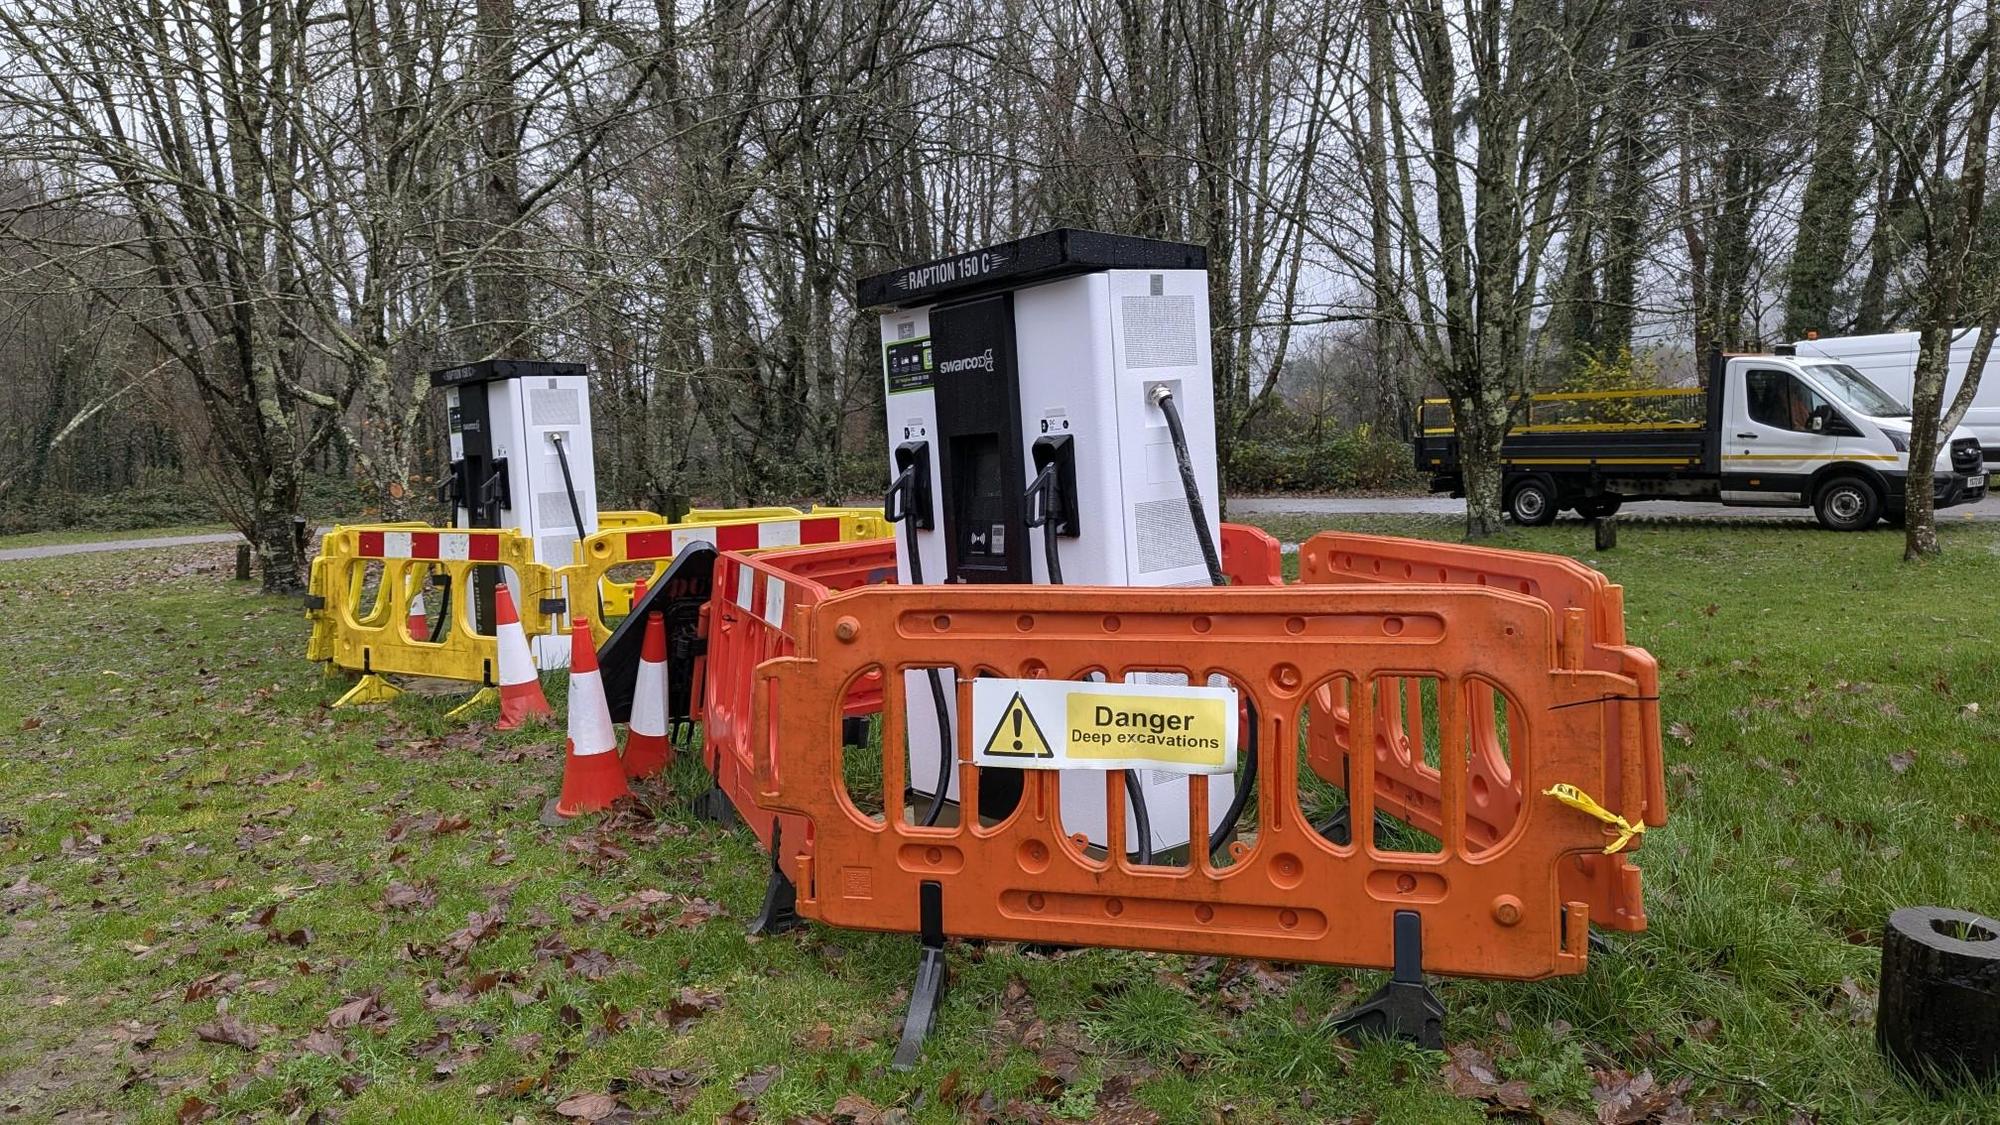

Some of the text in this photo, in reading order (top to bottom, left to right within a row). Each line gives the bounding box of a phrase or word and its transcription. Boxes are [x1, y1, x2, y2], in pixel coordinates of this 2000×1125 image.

[958, 257, 978, 278] 150
[981, 253, 990, 273] C
[940, 356, 978, 374] swarco
[1095, 705, 1195, 734] Danger
[1071, 729, 1219, 749] Deep excavations
